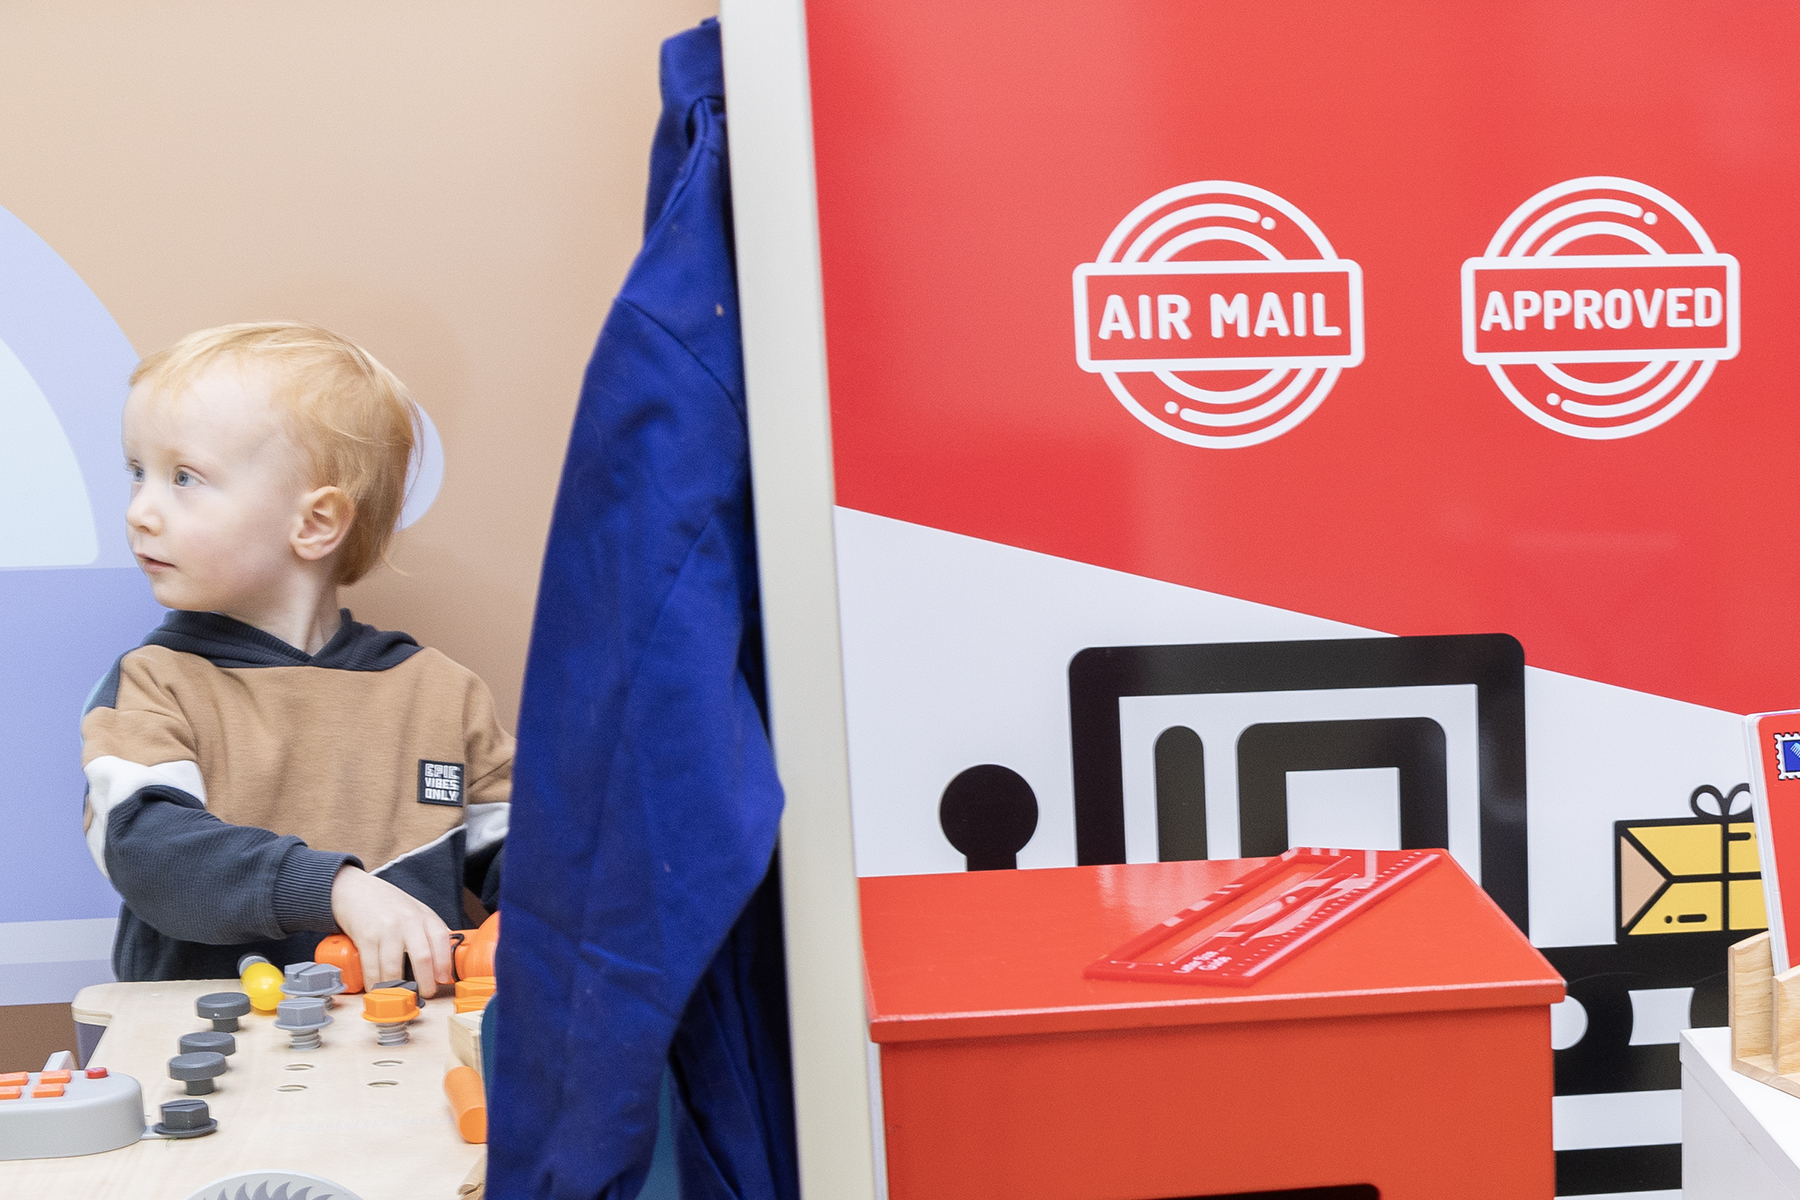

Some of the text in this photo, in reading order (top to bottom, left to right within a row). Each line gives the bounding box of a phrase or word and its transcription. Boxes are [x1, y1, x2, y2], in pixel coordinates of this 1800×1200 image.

[1098, 291, 1343, 341] AIR MAIL
[1480, 287, 1724, 332] APPROVED
[424, 763, 461, 780] EPIC
[424, 776, 460, 791] VIBES
[424, 787, 460, 802] ONLY
